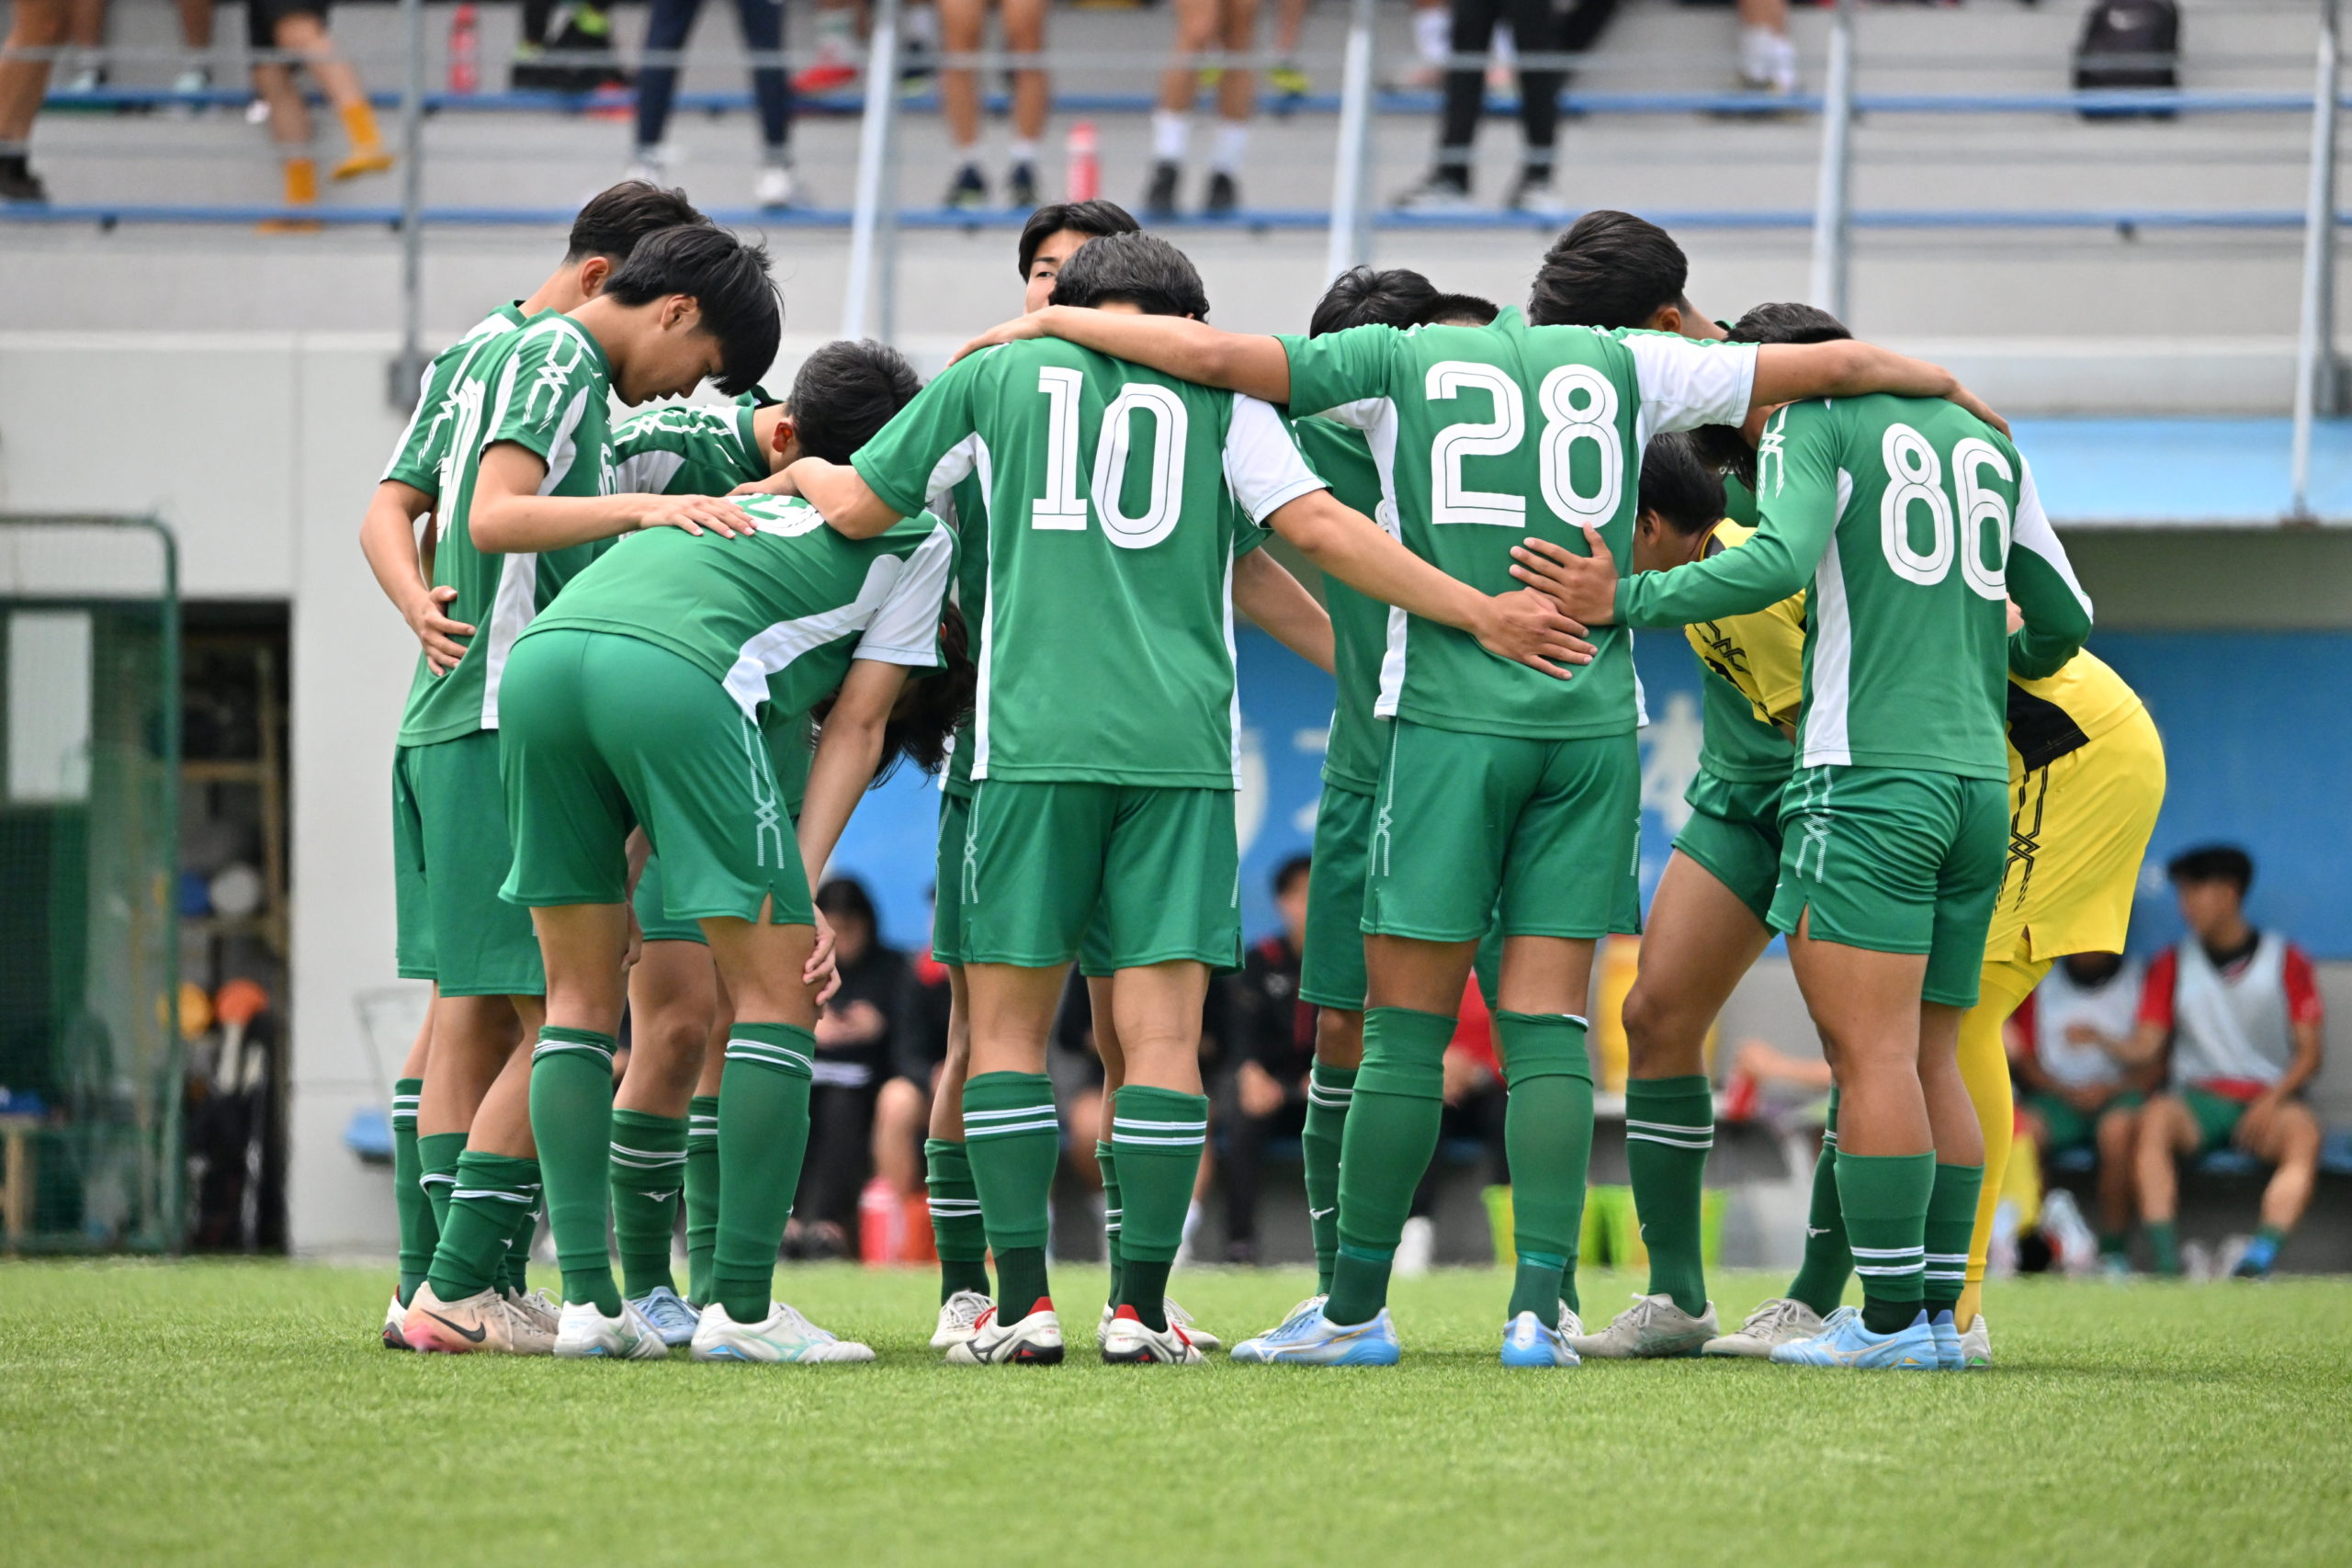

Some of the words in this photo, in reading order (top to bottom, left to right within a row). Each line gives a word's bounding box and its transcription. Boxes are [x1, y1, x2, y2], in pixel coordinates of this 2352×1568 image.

[1032, 366, 1188, 548] 10
[1425, 360, 1623, 527] 28
[1881, 423, 2013, 601] 86
